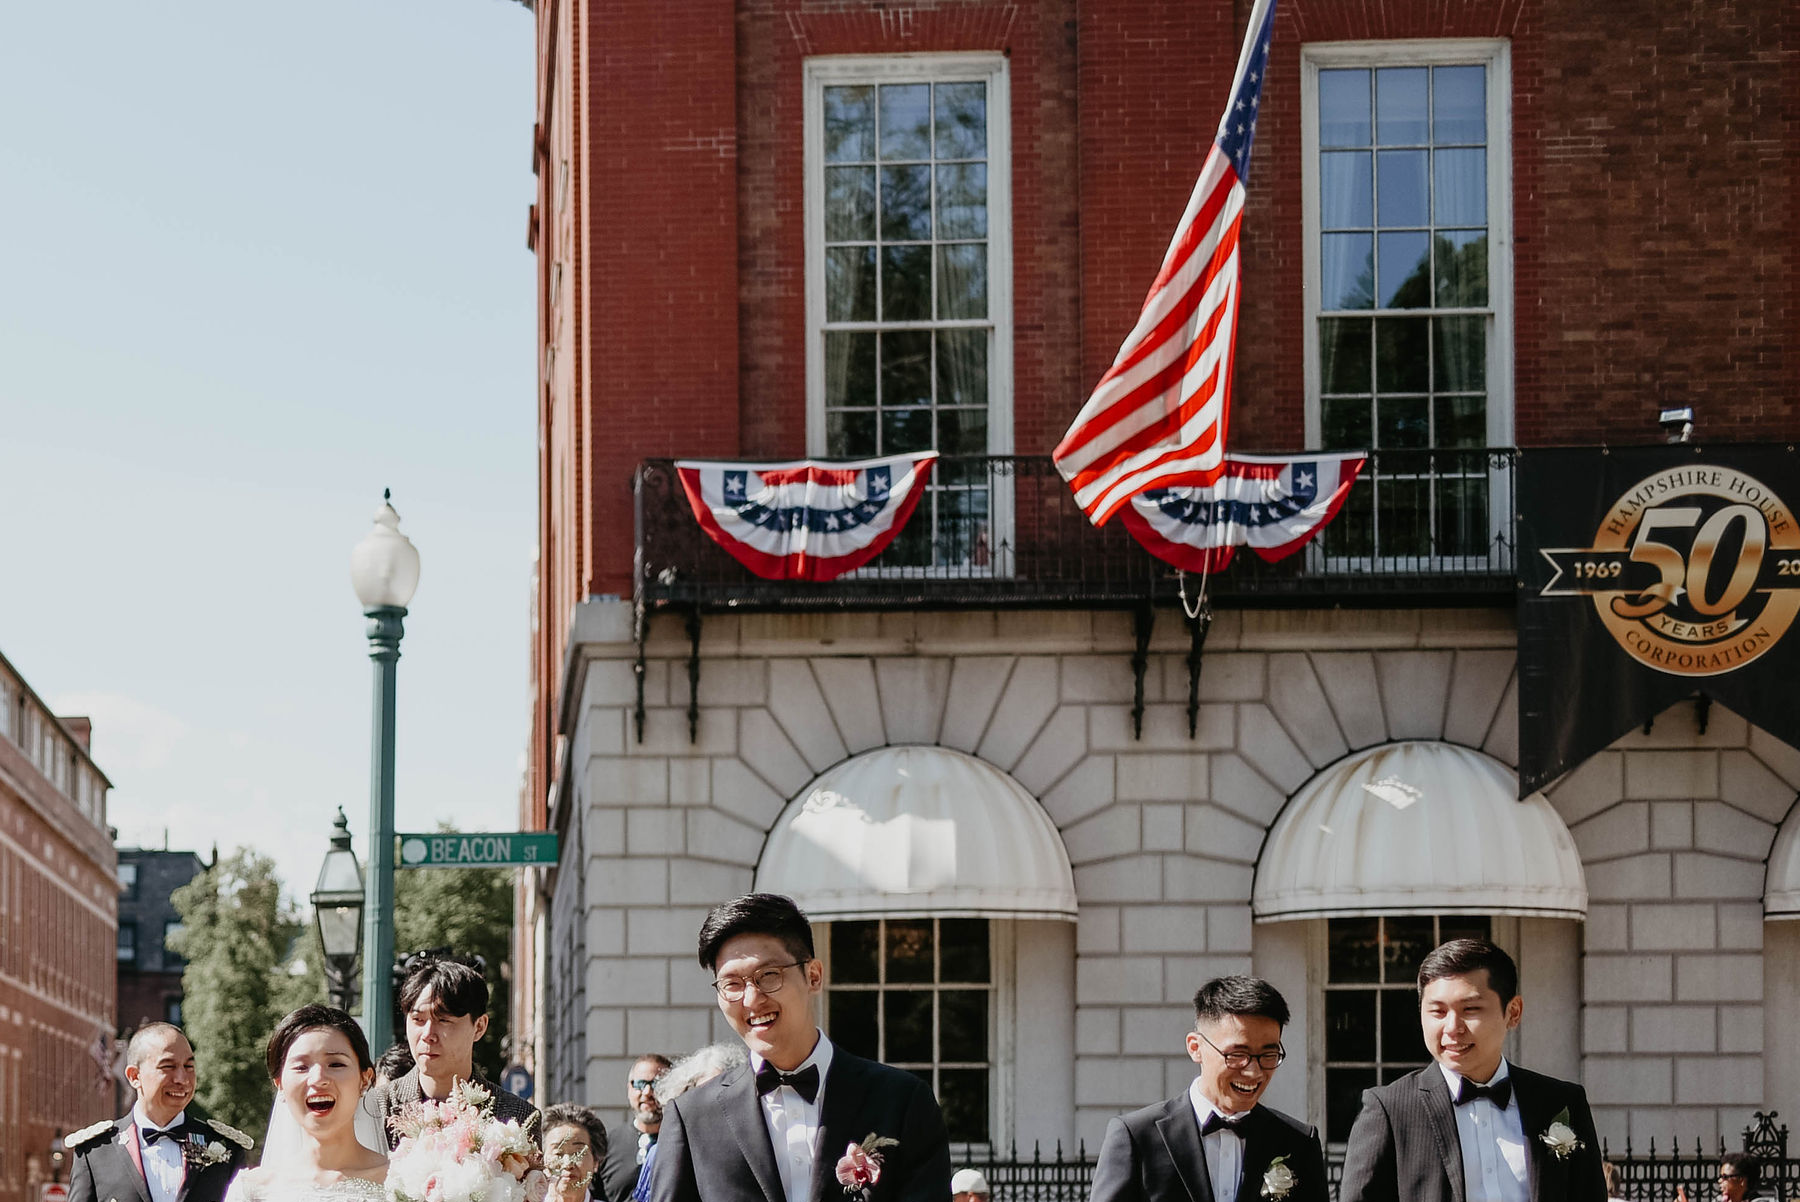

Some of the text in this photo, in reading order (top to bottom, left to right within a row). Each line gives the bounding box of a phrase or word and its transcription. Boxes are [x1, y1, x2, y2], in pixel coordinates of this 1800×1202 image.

[1607, 471, 1790, 535] HAMPSHIRE HOUSE
[1574, 561, 1622, 578] 1969
[1610, 504, 1766, 617] 50
[1660, 616, 1729, 637] YEARS
[1626, 626, 1771, 668] CORPORATION
[431, 838, 538, 862] BEACON ST
[511, 1073, 527, 1096] P
